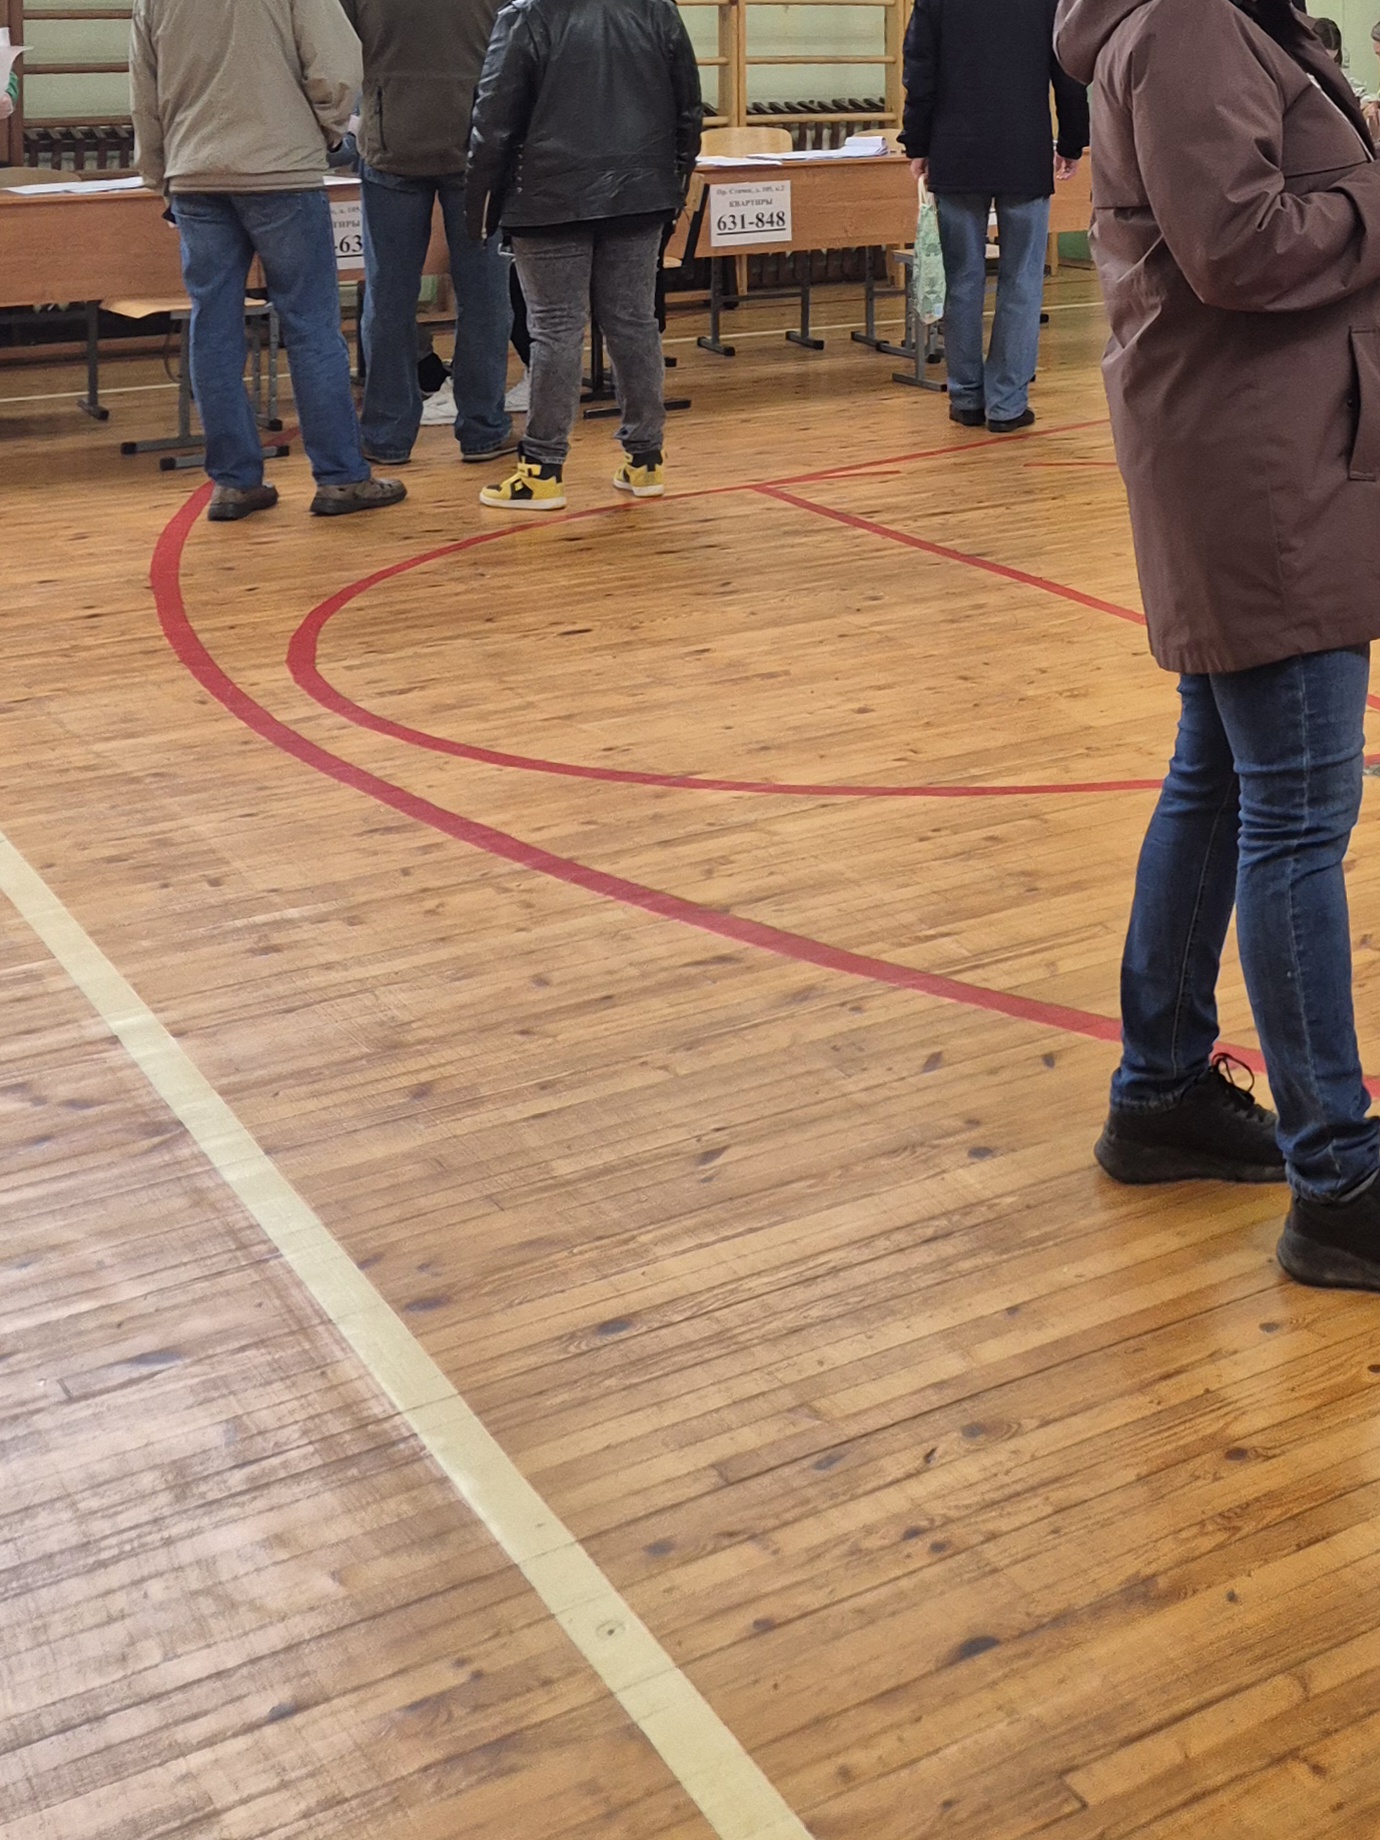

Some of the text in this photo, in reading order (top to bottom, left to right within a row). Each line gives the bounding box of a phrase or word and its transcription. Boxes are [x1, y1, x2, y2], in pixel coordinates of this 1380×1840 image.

[729, 199, 773, 207] КВАРТИРЫ
[717, 211, 785, 231] 631-848
[334, 234, 363, 253] -63
